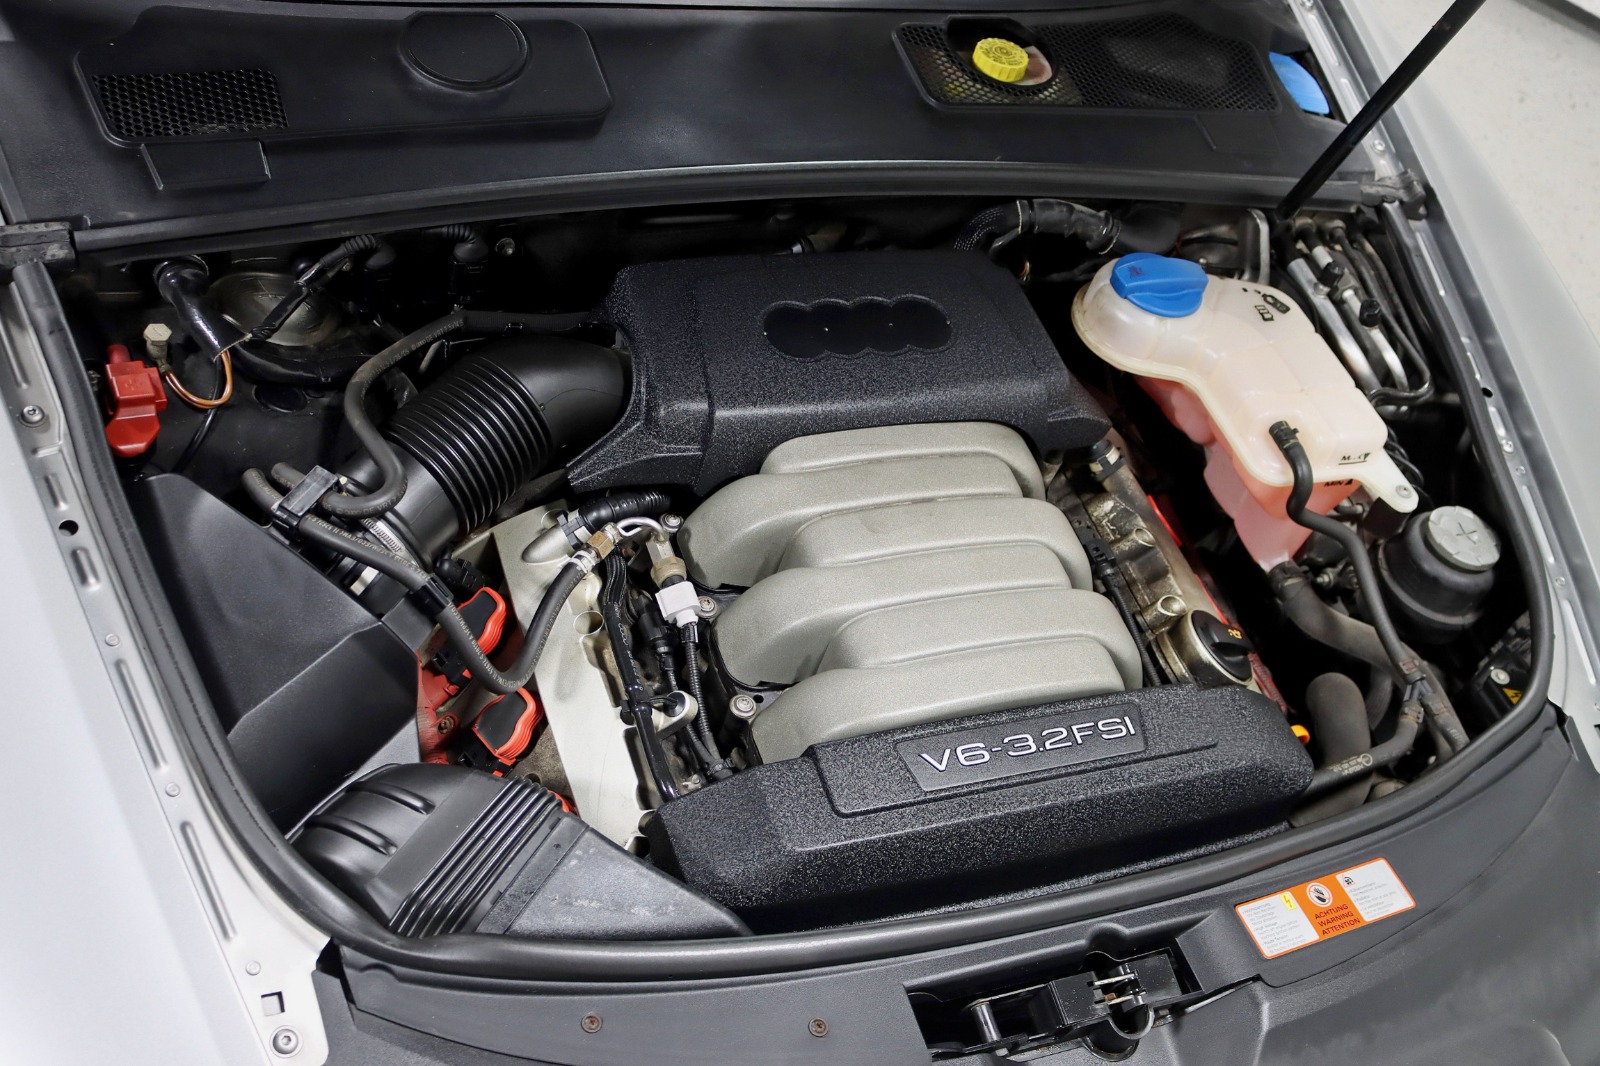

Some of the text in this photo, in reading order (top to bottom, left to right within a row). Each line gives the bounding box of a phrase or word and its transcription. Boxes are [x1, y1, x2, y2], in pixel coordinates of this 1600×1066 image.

[919, 716, 1136, 772] V6-3.2FSI
[1314, 903, 1349, 920] ACHTUNG
[1318, 911, 1354, 927] WARNING
[1322, 918, 1361, 936] ATTENTION
